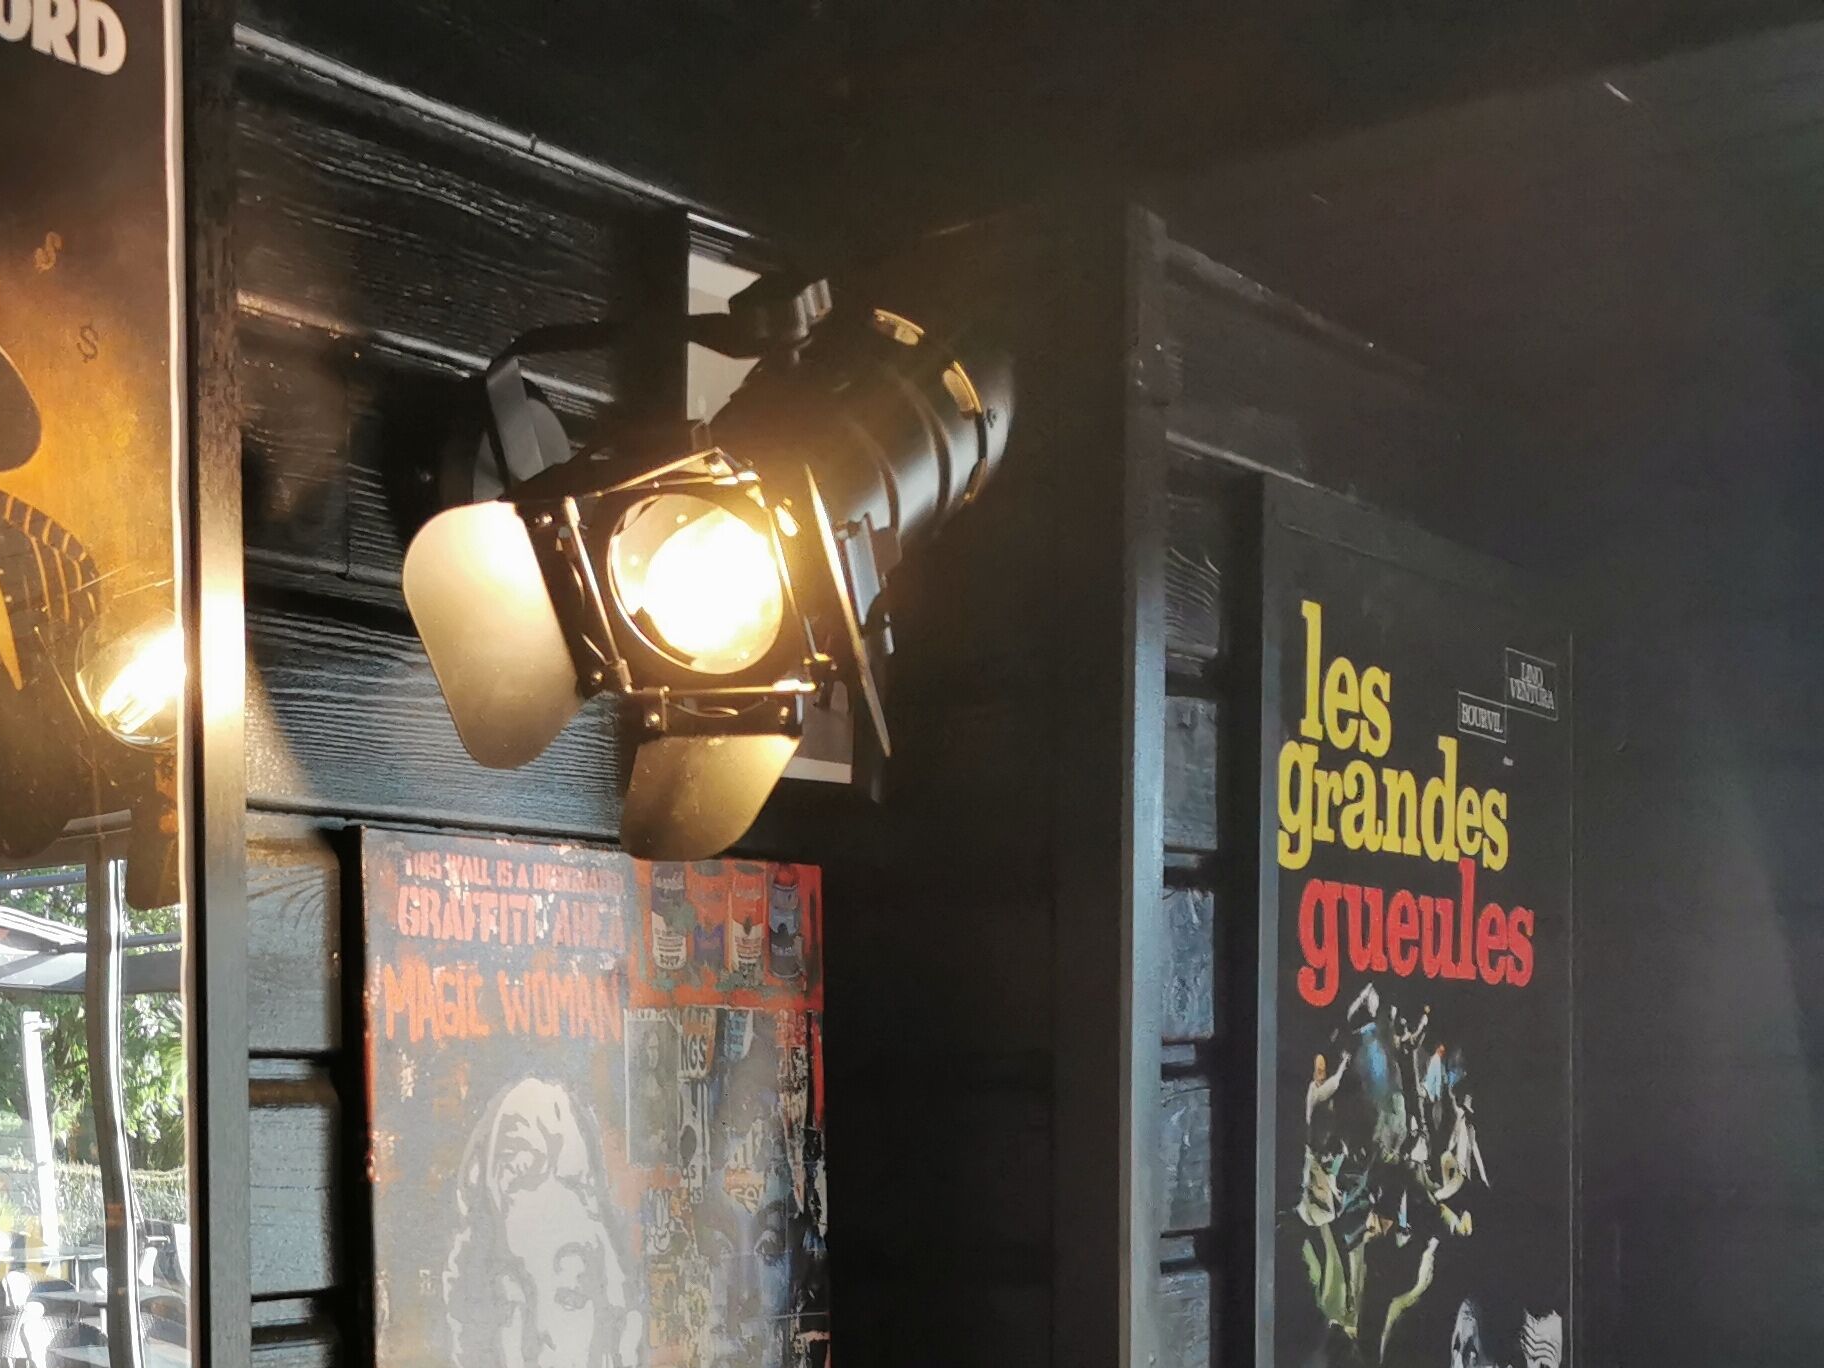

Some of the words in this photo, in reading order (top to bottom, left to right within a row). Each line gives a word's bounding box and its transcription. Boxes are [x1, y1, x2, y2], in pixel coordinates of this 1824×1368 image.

[1300, 600, 1392, 758] les
[1509, 677, 1555, 710] VENTURA
[1461, 702, 1504, 733] BOURVIL
[1277, 735, 1509, 872] grandes
[495, 859, 514, 888] IS
[516, 862, 530, 889] A
[397, 884, 537, 945] GRAFFITI
[1297, 857, 1535, 1007] gueules
[383, 955, 491, 1043] MAGIC
[497, 968, 622, 1043] WOMAN
